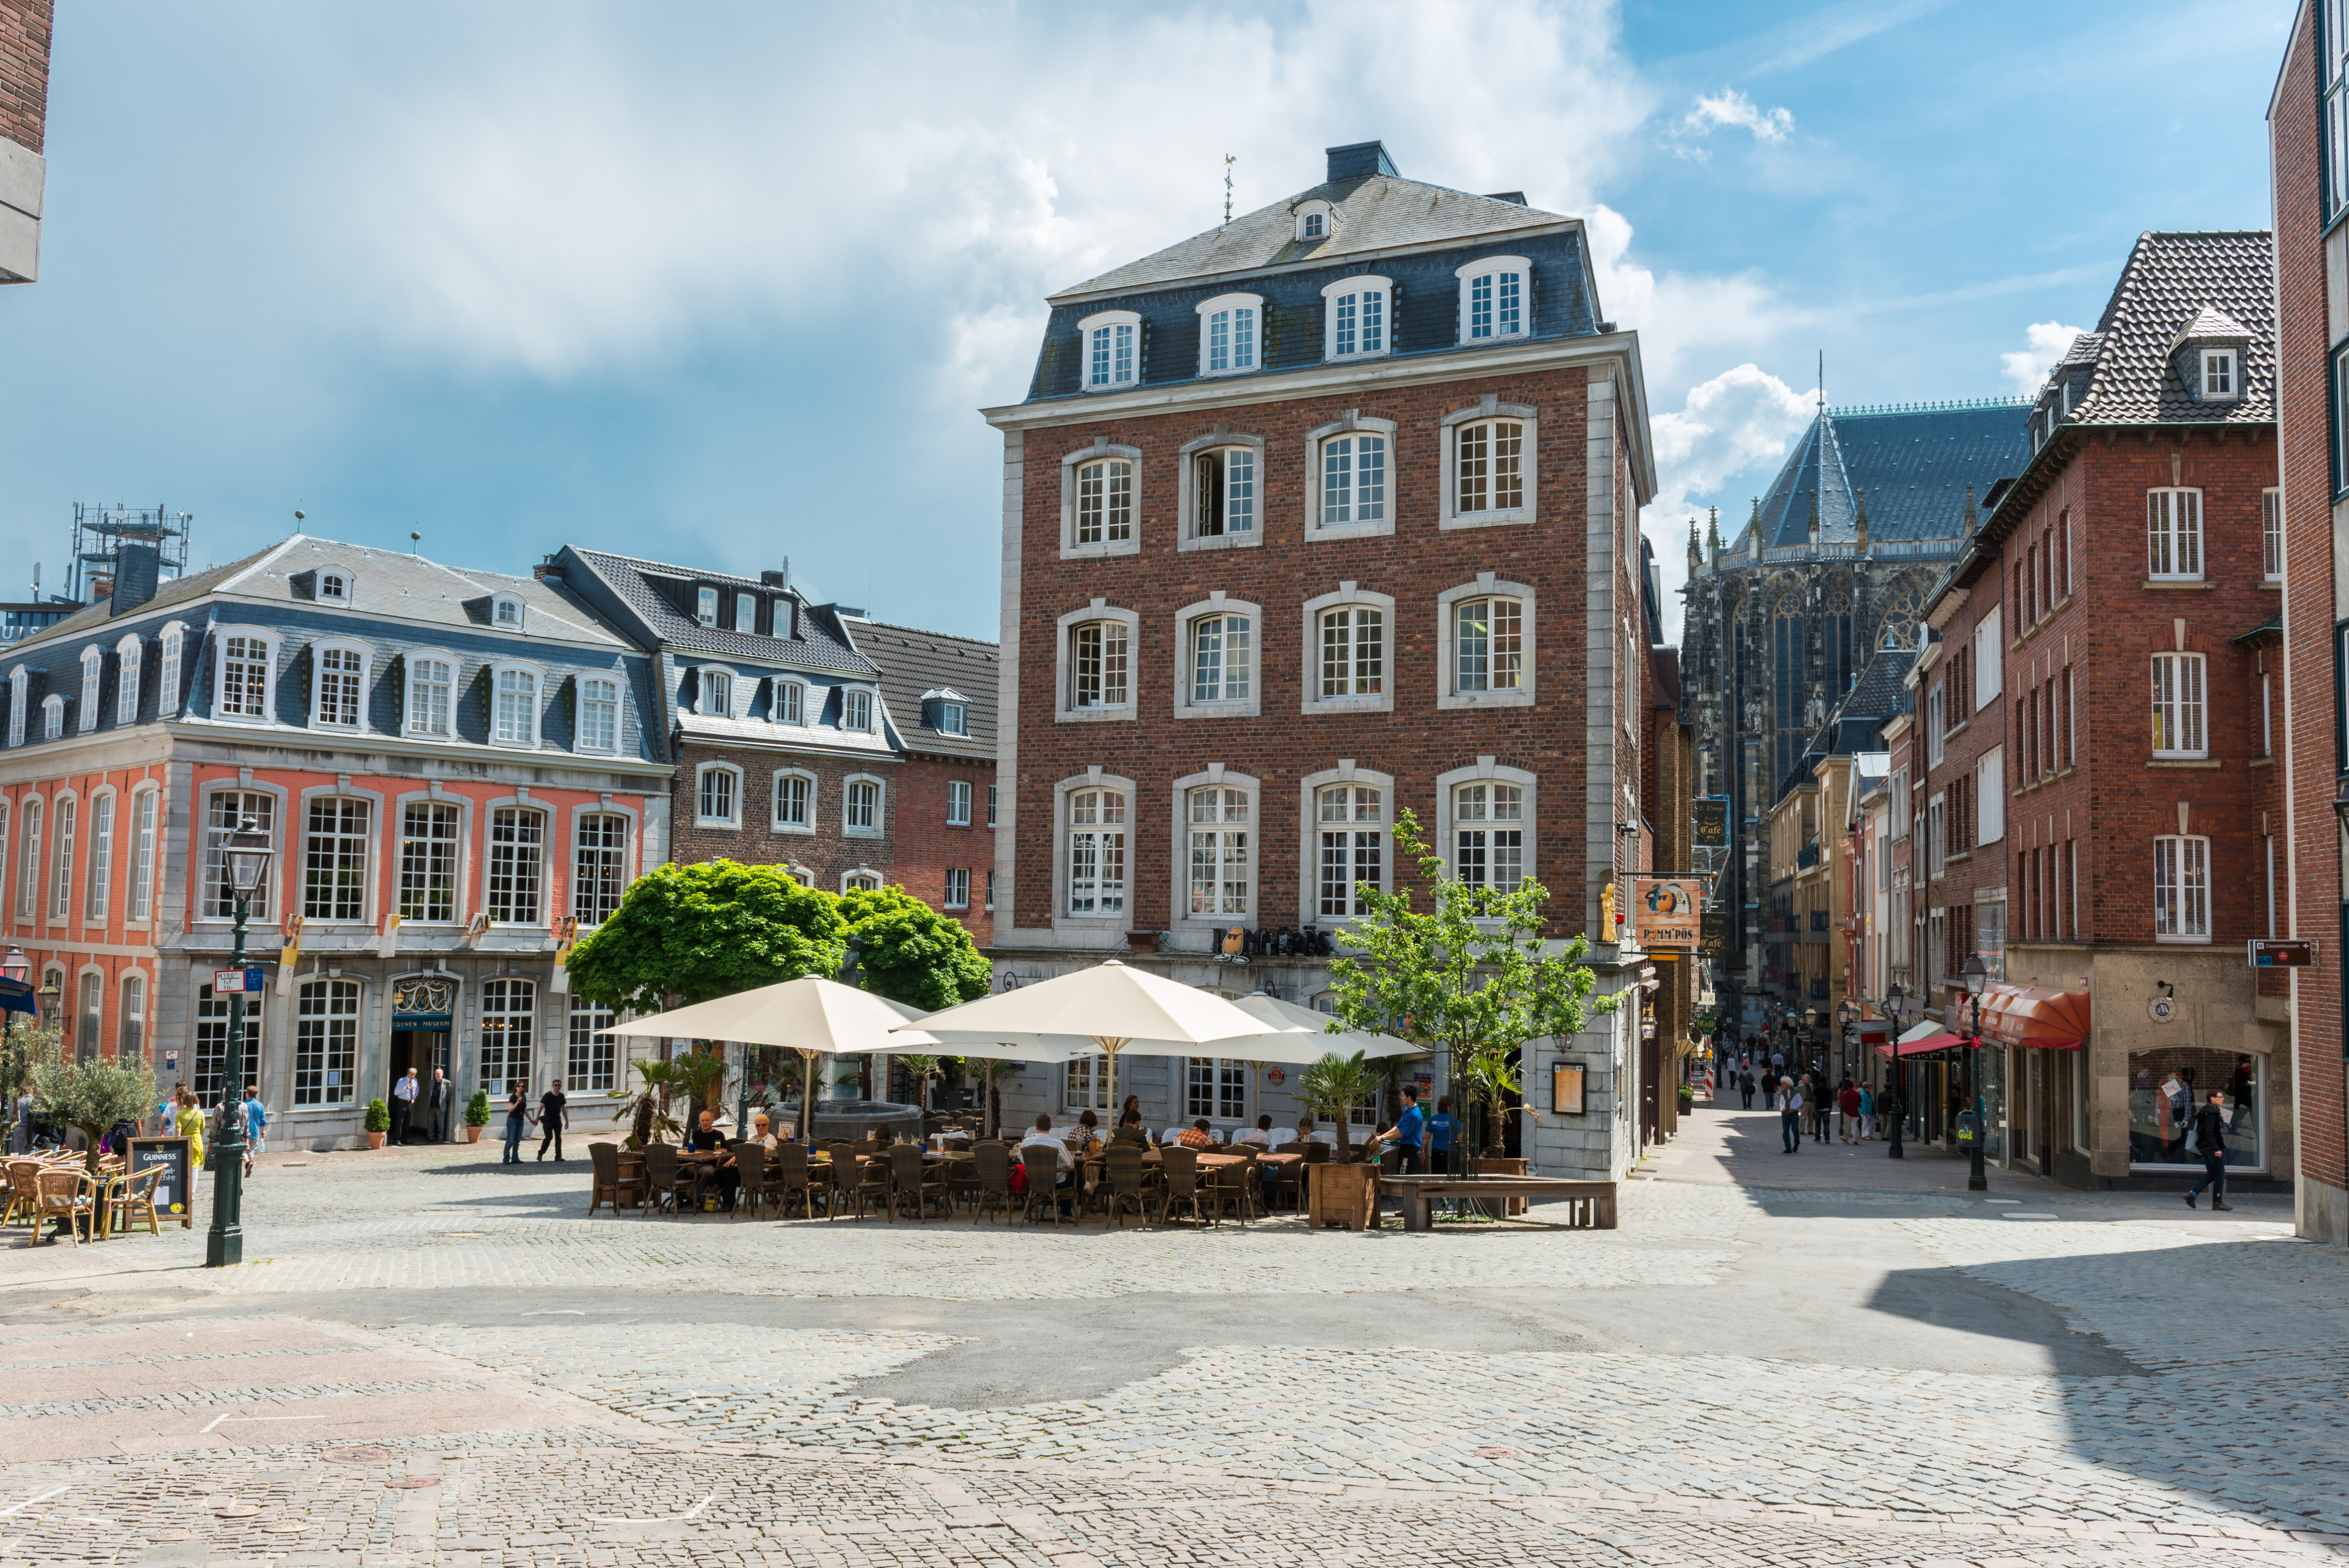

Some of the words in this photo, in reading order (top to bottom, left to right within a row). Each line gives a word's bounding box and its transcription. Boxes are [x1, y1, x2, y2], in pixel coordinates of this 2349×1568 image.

[1701, 825, 1721, 836] Café
[1701, 938, 1721, 949] Café
[1699, 1019, 1714, 1028] Café
[2164, 1084, 2178, 1094] 20%
